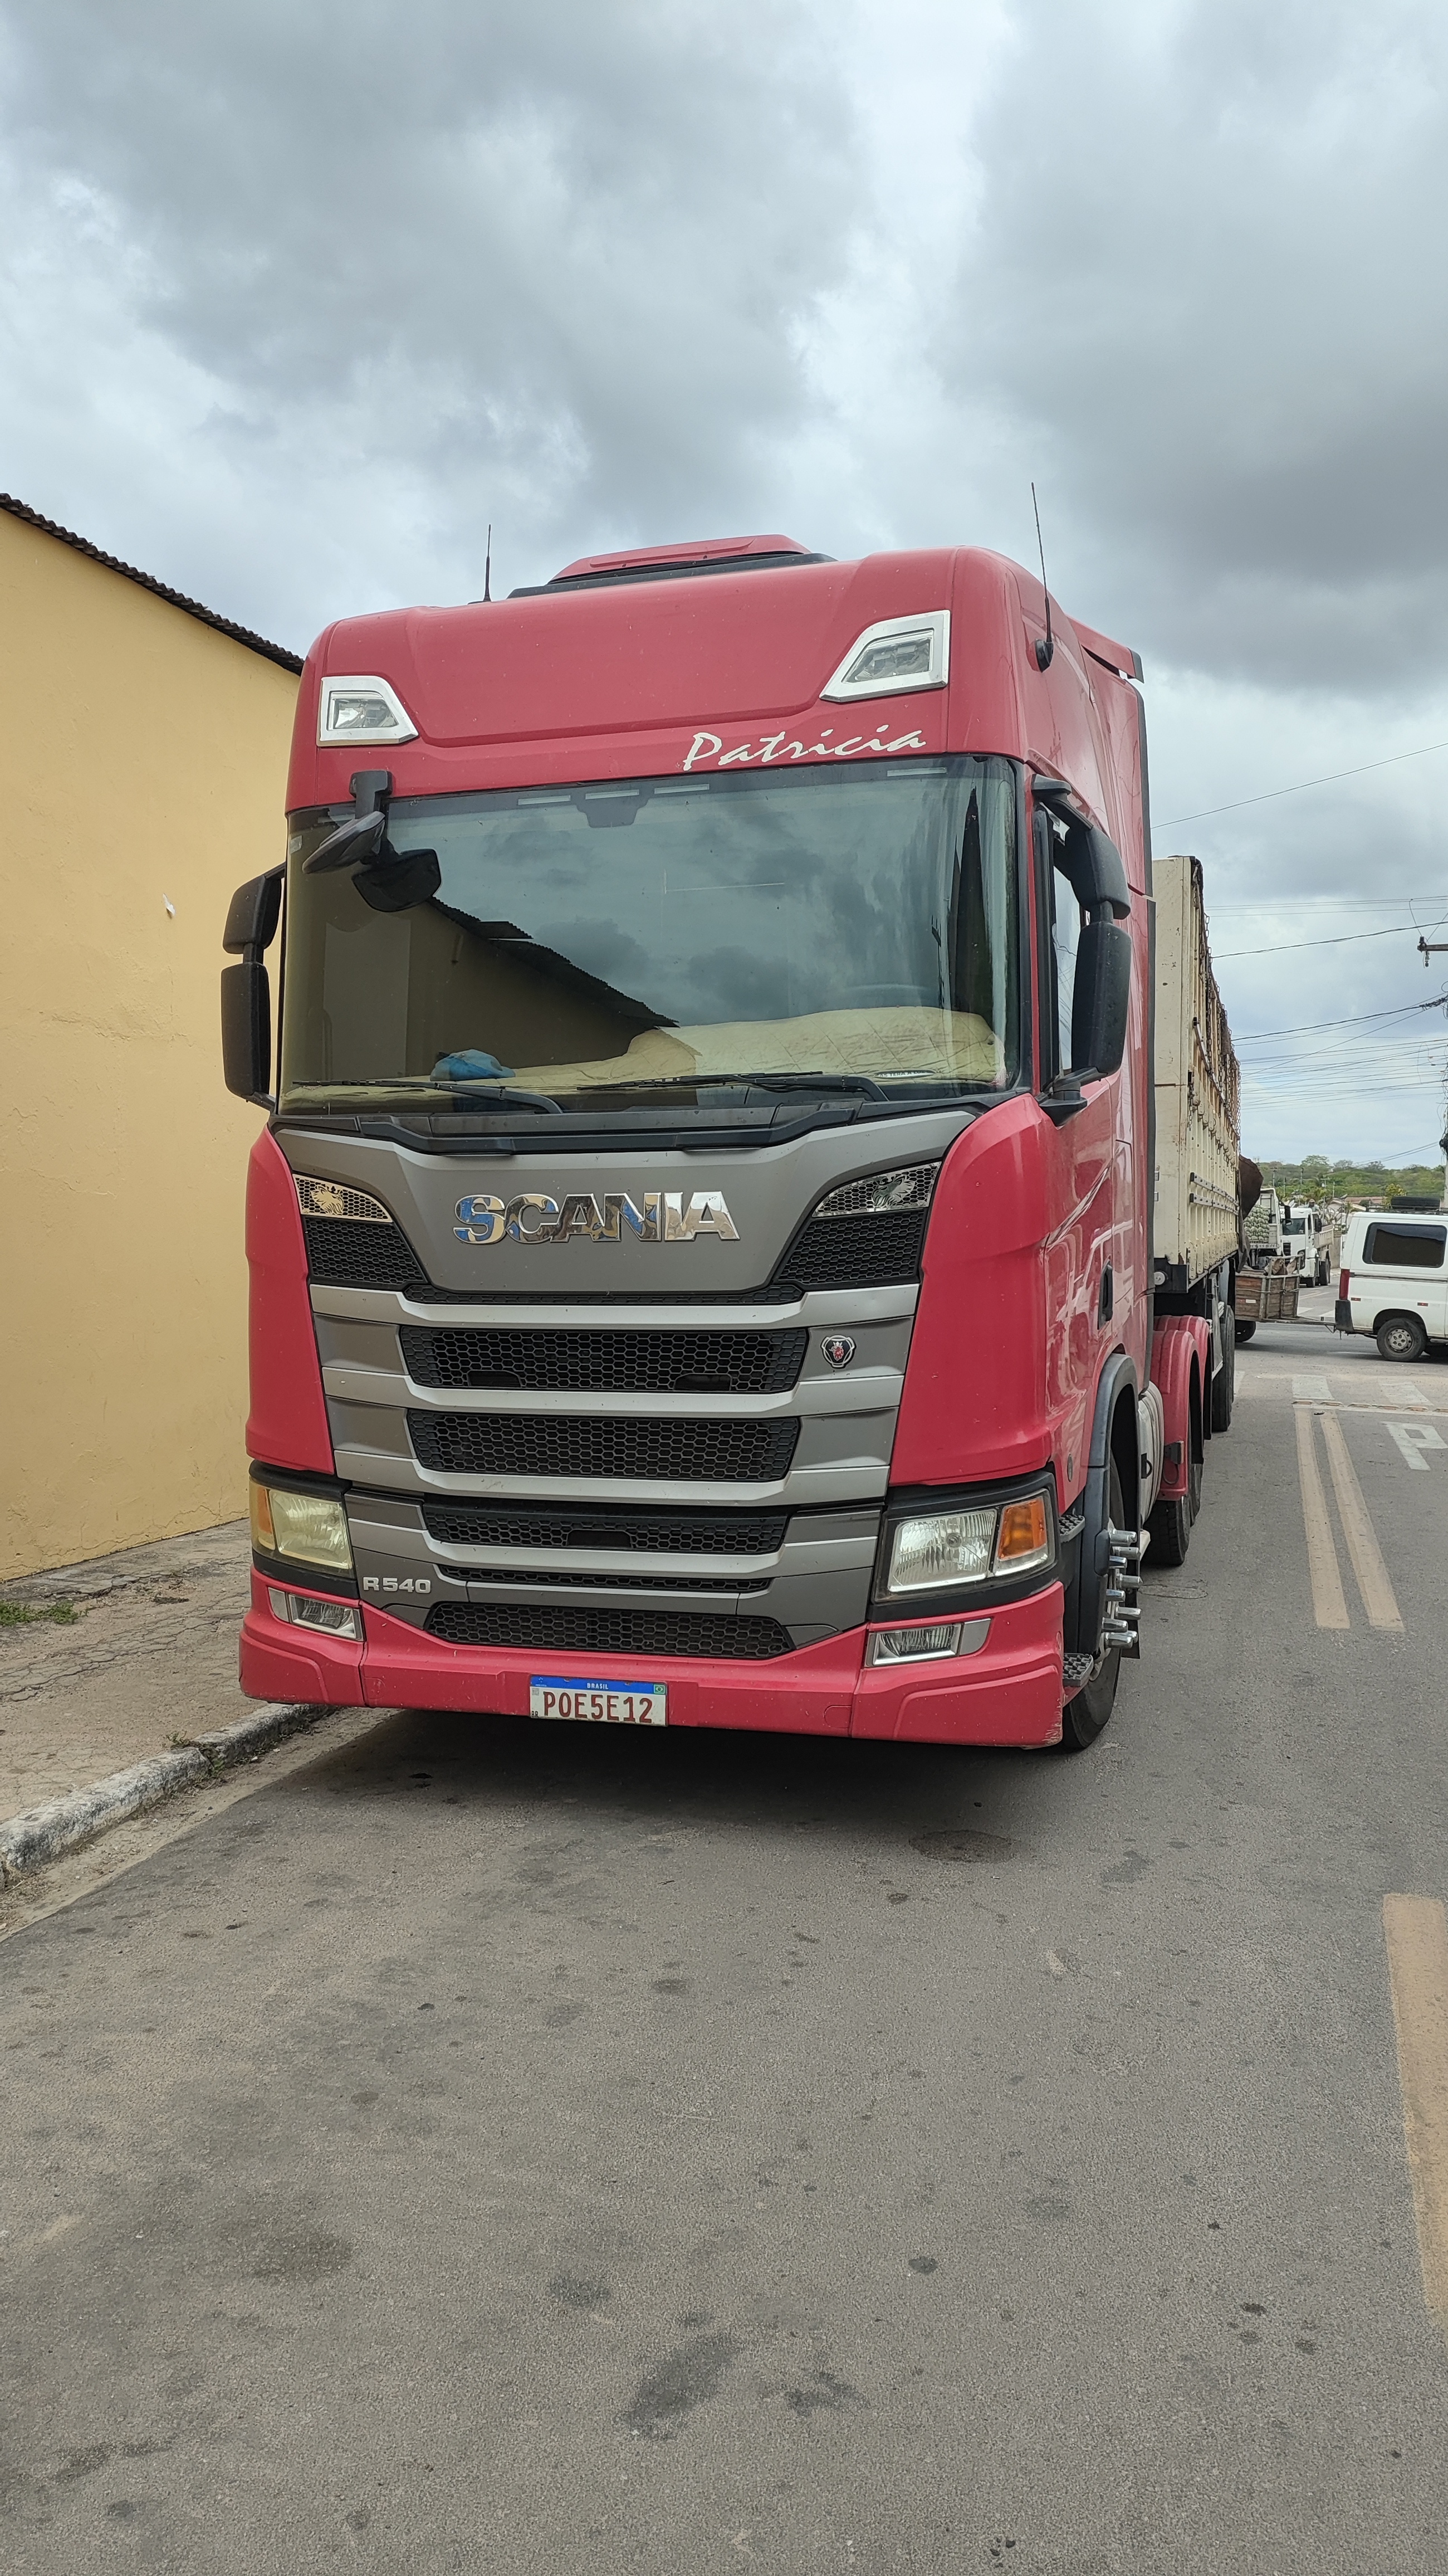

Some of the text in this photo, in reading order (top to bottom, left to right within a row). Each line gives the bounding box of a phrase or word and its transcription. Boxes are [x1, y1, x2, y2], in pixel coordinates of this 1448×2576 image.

[683, 725, 926, 771] Patricia
[453, 1191, 740, 1245] SCANIA
[542, 1691, 653, 1723] POE5E12
